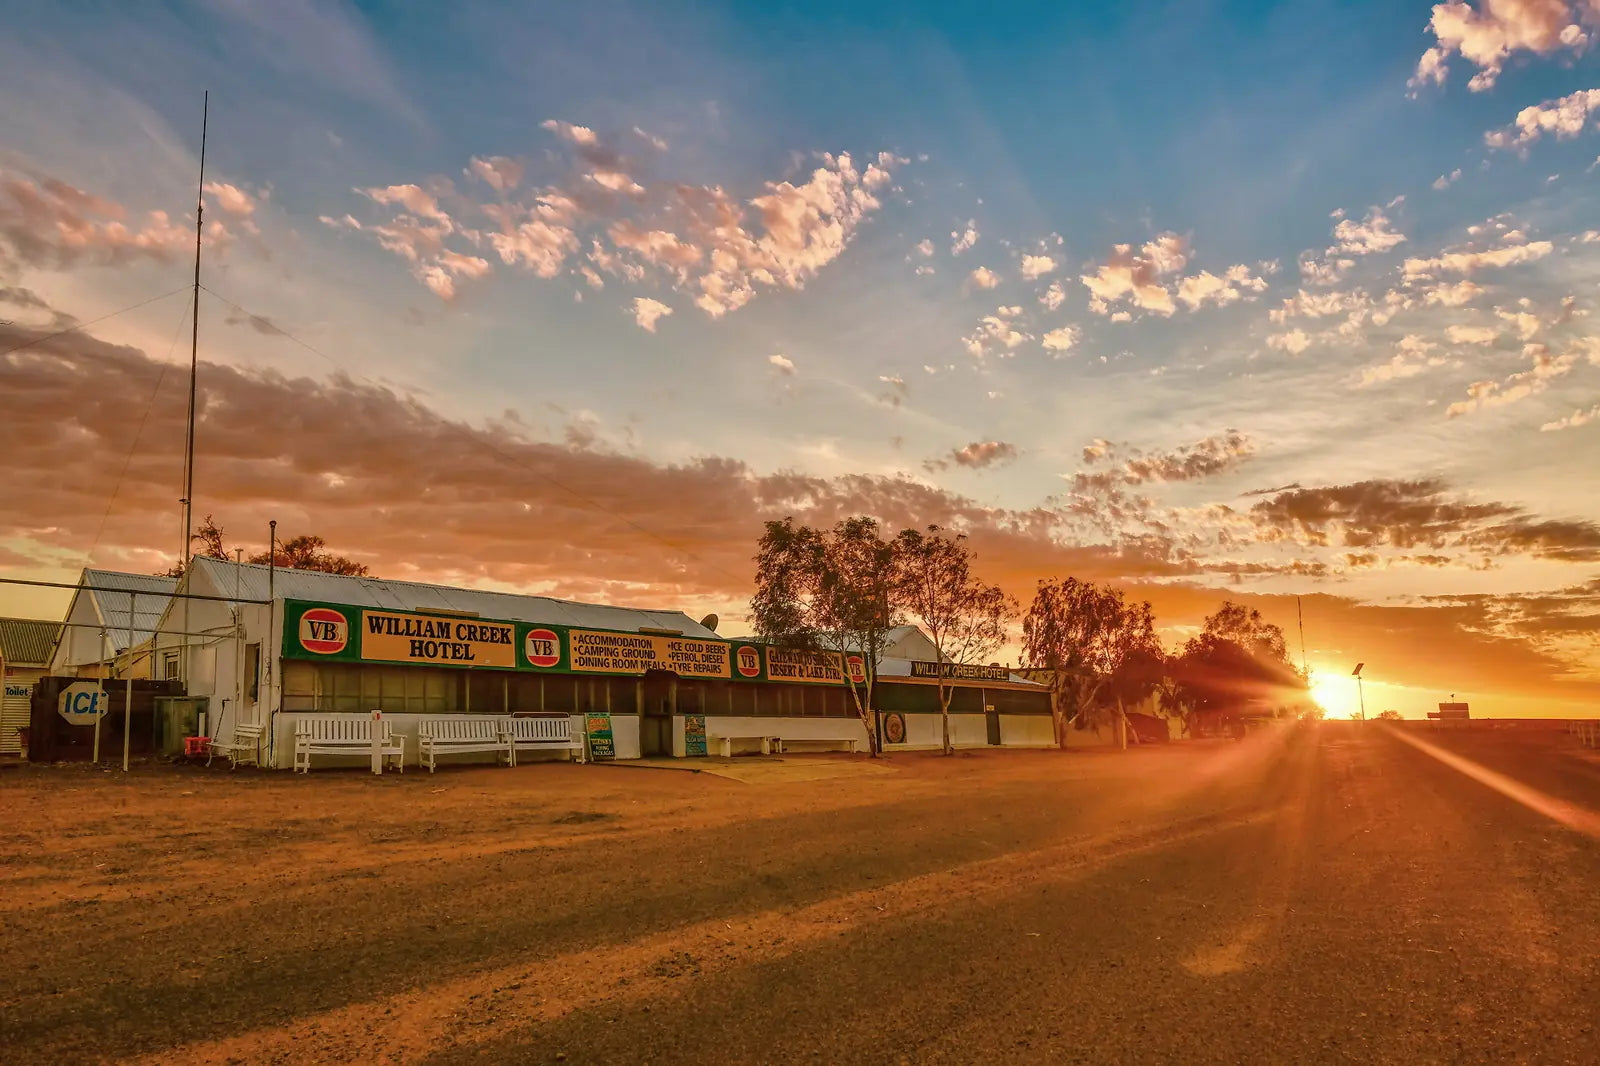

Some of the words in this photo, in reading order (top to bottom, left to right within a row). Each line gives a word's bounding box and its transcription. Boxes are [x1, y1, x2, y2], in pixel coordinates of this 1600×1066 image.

[308, 620, 339, 641] VB
[368, 616, 450, 639] WILLIAM
[455, 624, 511, 644] CREEK
[531, 640, 552, 656] VB
[578, 635, 652, 648] ACCOMMODATION
[671, 642, 682, 651] ICE
[685, 643, 703, 652] COLD
[706, 645, 726, 654] BEERS
[410, 640, 475, 660] HOTEL
[577, 645, 619, 657] CAMPING
[622, 648, 656, 659] GROUND
[578, 657, 610, 668] DINING
[612, 659, 638, 669] ROOM
[640, 660, 666, 671] MEALS
[701, 654, 724, 664] DIESEL
[741, 655, 754, 667] VB
[673, 663, 692, 672] TYRE
[693, 664, 722, 673] REPAIRS
[770, 664, 796, 677] DESERT
[799, 666, 804, 677] &
[806, 666, 824, 678] LAKE
[825, 667, 841, 679] EYRE
[849, 664, 861, 675] VB
[981, 667, 1006, 678] HOTEL
[5, 688, 28, 696] Toilet
